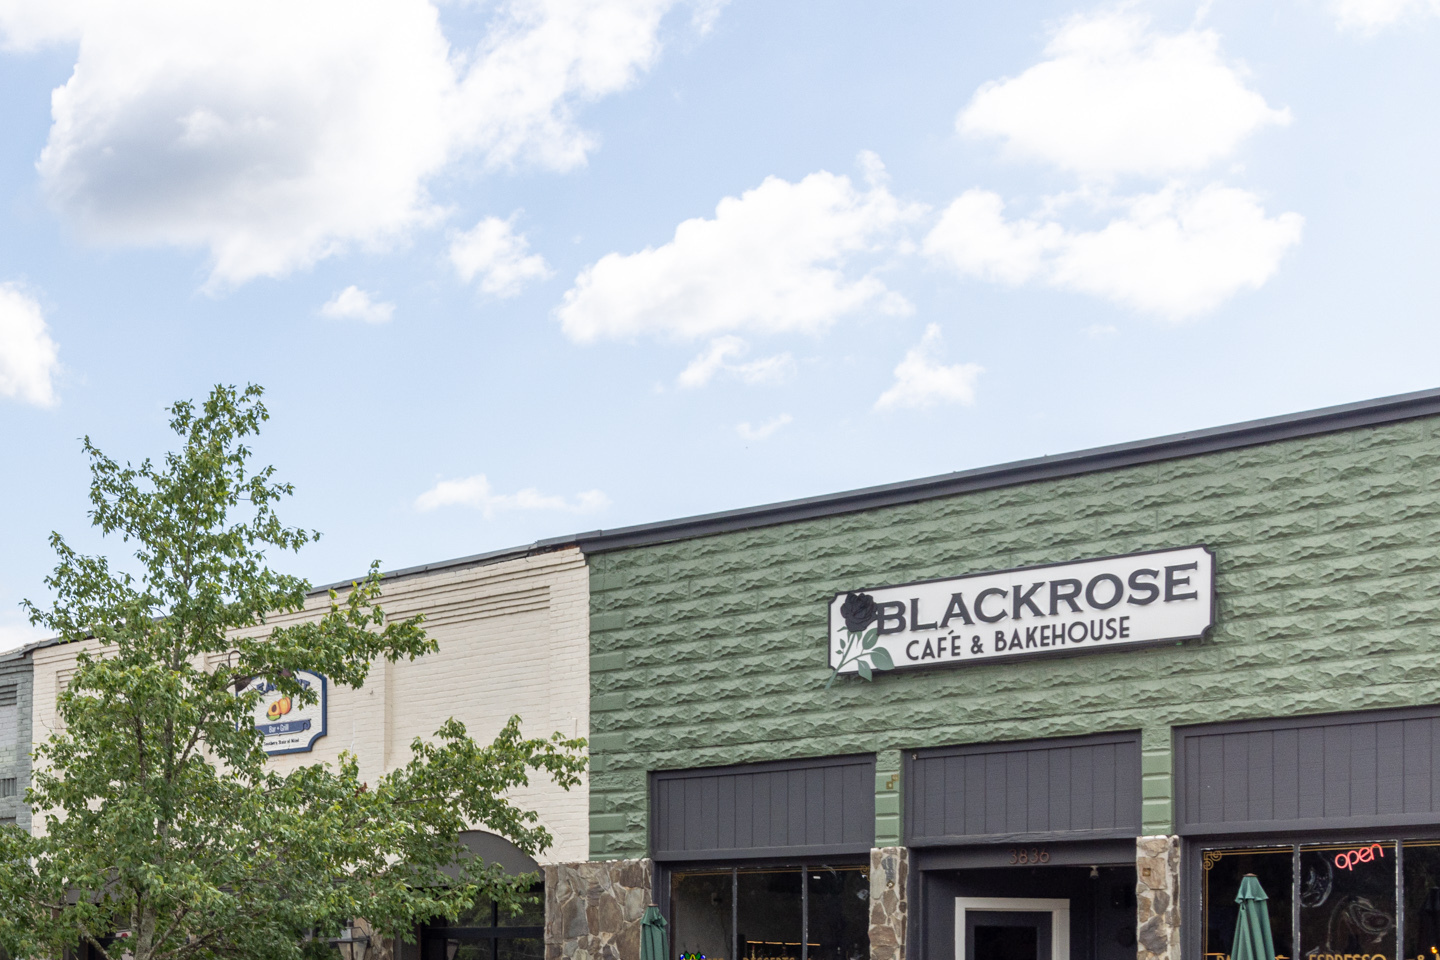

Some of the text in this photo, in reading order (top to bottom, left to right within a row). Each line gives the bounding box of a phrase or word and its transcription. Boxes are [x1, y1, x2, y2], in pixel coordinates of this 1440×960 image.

[876, 561, 1198, 636] BLACKROSE
[906, 616, 1130, 661] CAFÉ & BAKEHOUSE
[280, 724, 290, 732] Grill
[1010, 848, 1050, 864] 3836
[1334, 843, 1384, 871] open
